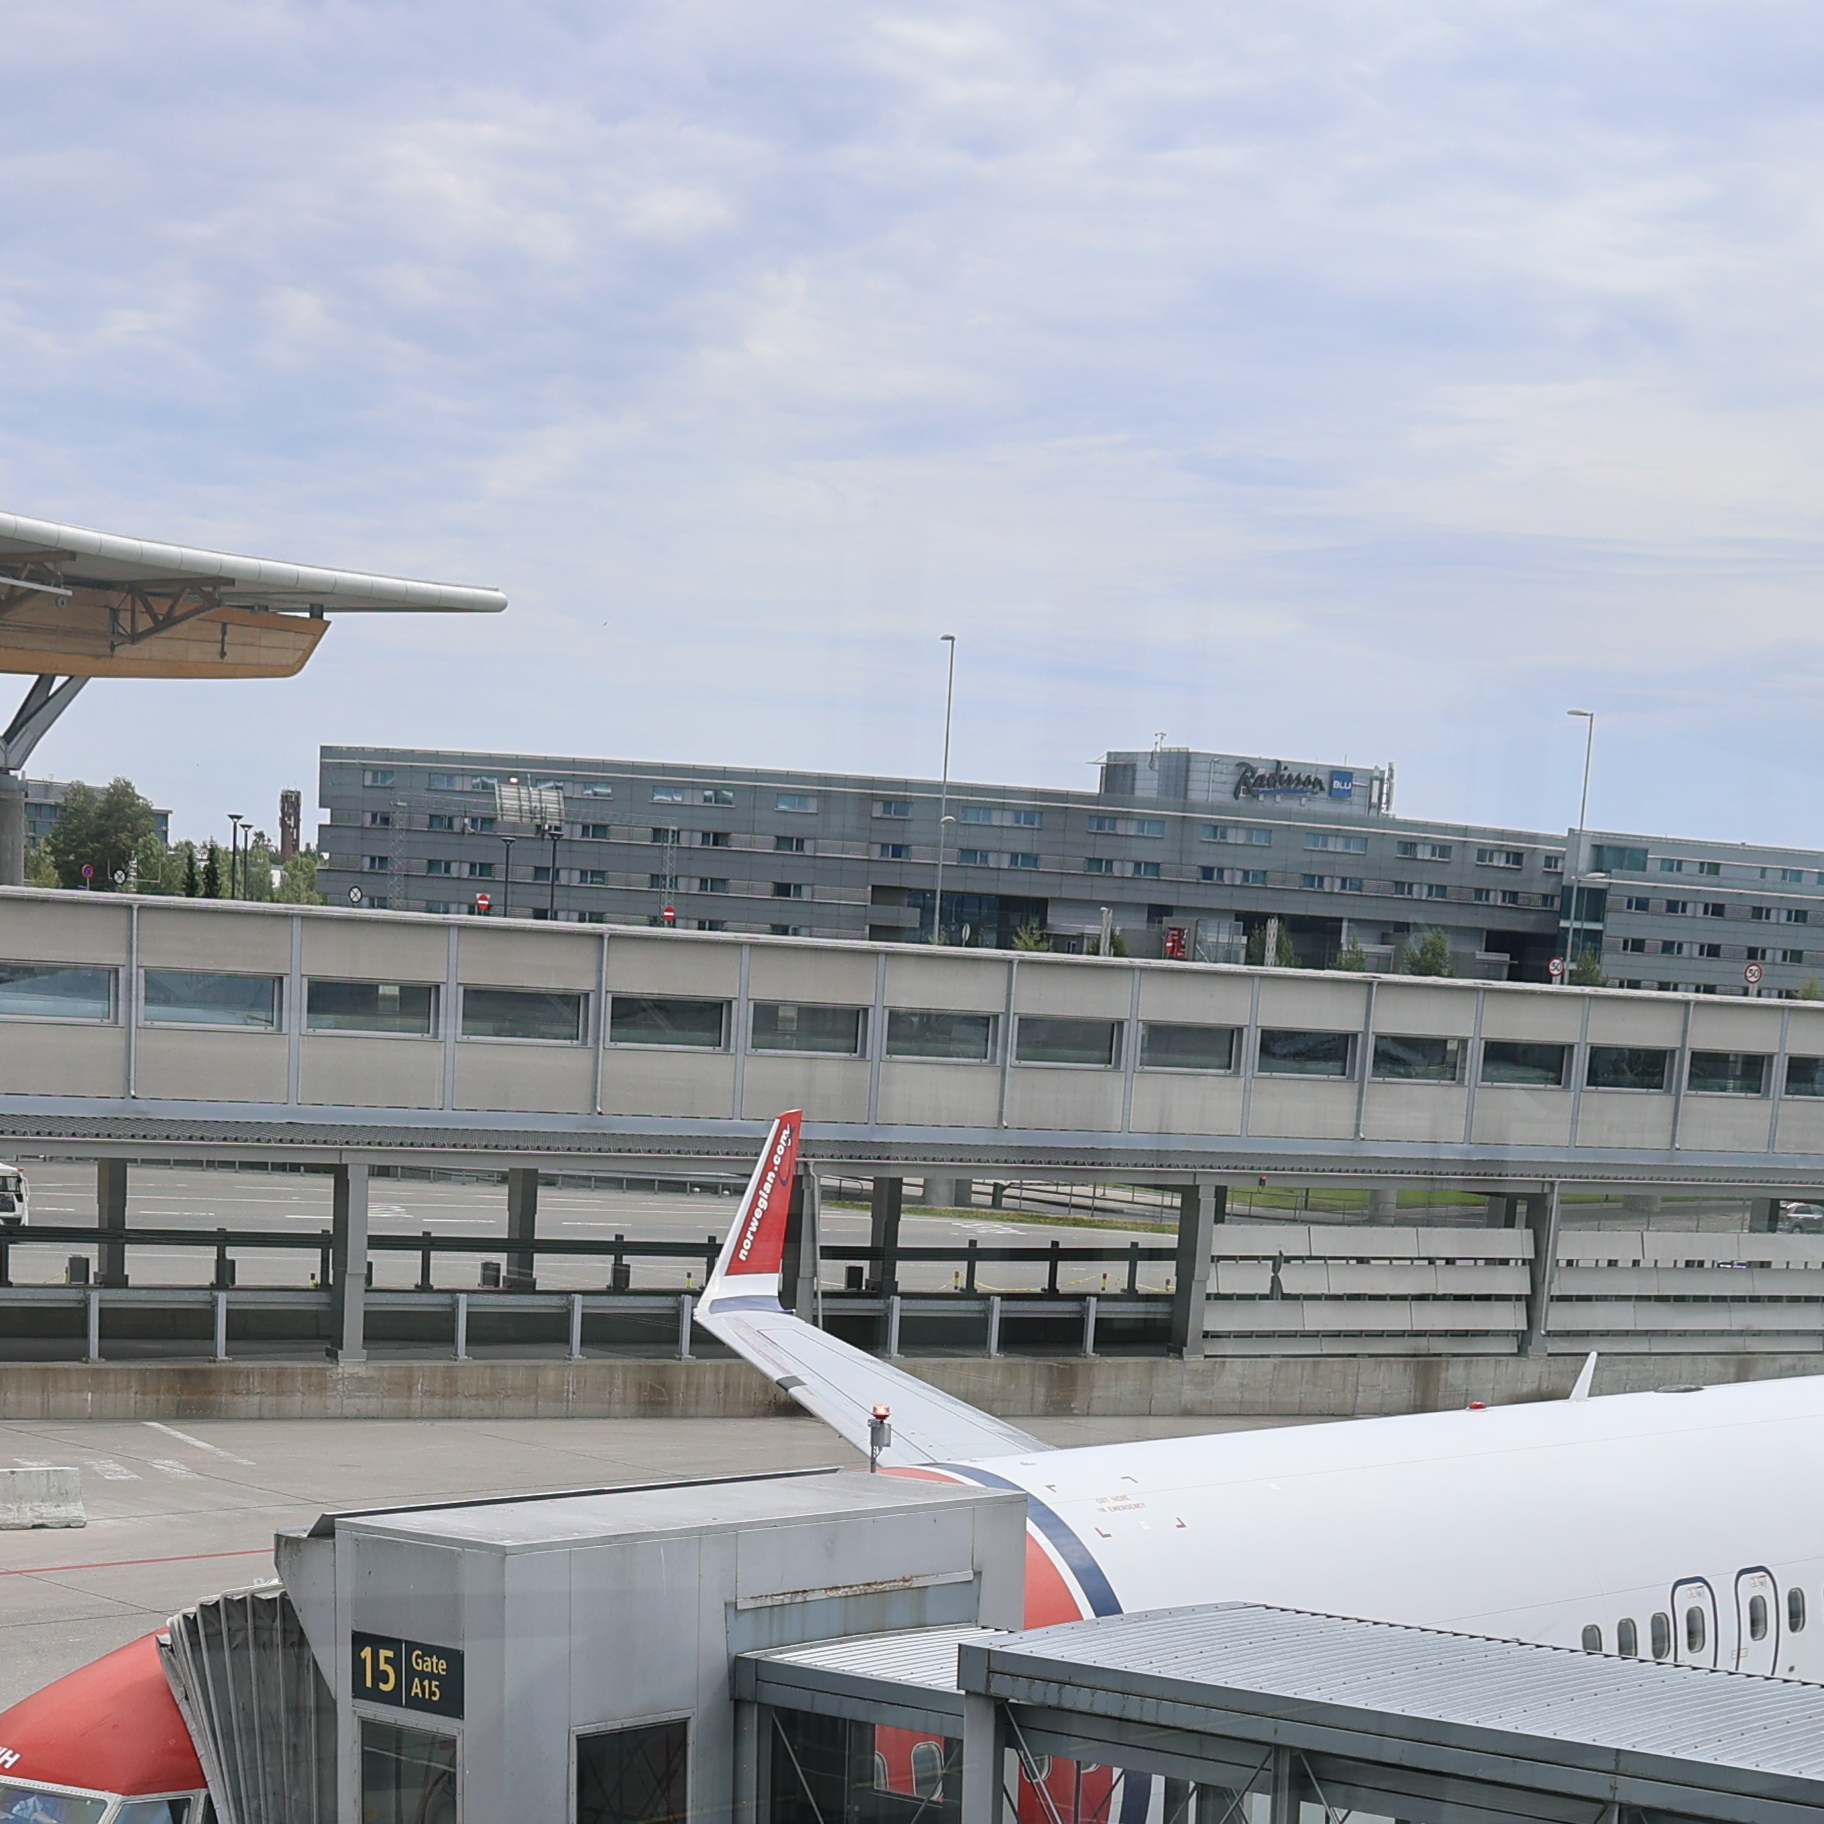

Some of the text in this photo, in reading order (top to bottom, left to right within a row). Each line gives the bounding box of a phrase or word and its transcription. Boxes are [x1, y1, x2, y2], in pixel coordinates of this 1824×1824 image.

[1233, 760, 1352, 800] Radisson BLU
[360, 1646, 396, 1692] 15
[411, 1649, 447, 1676] Gate
[410, 1677, 441, 1701] A15
